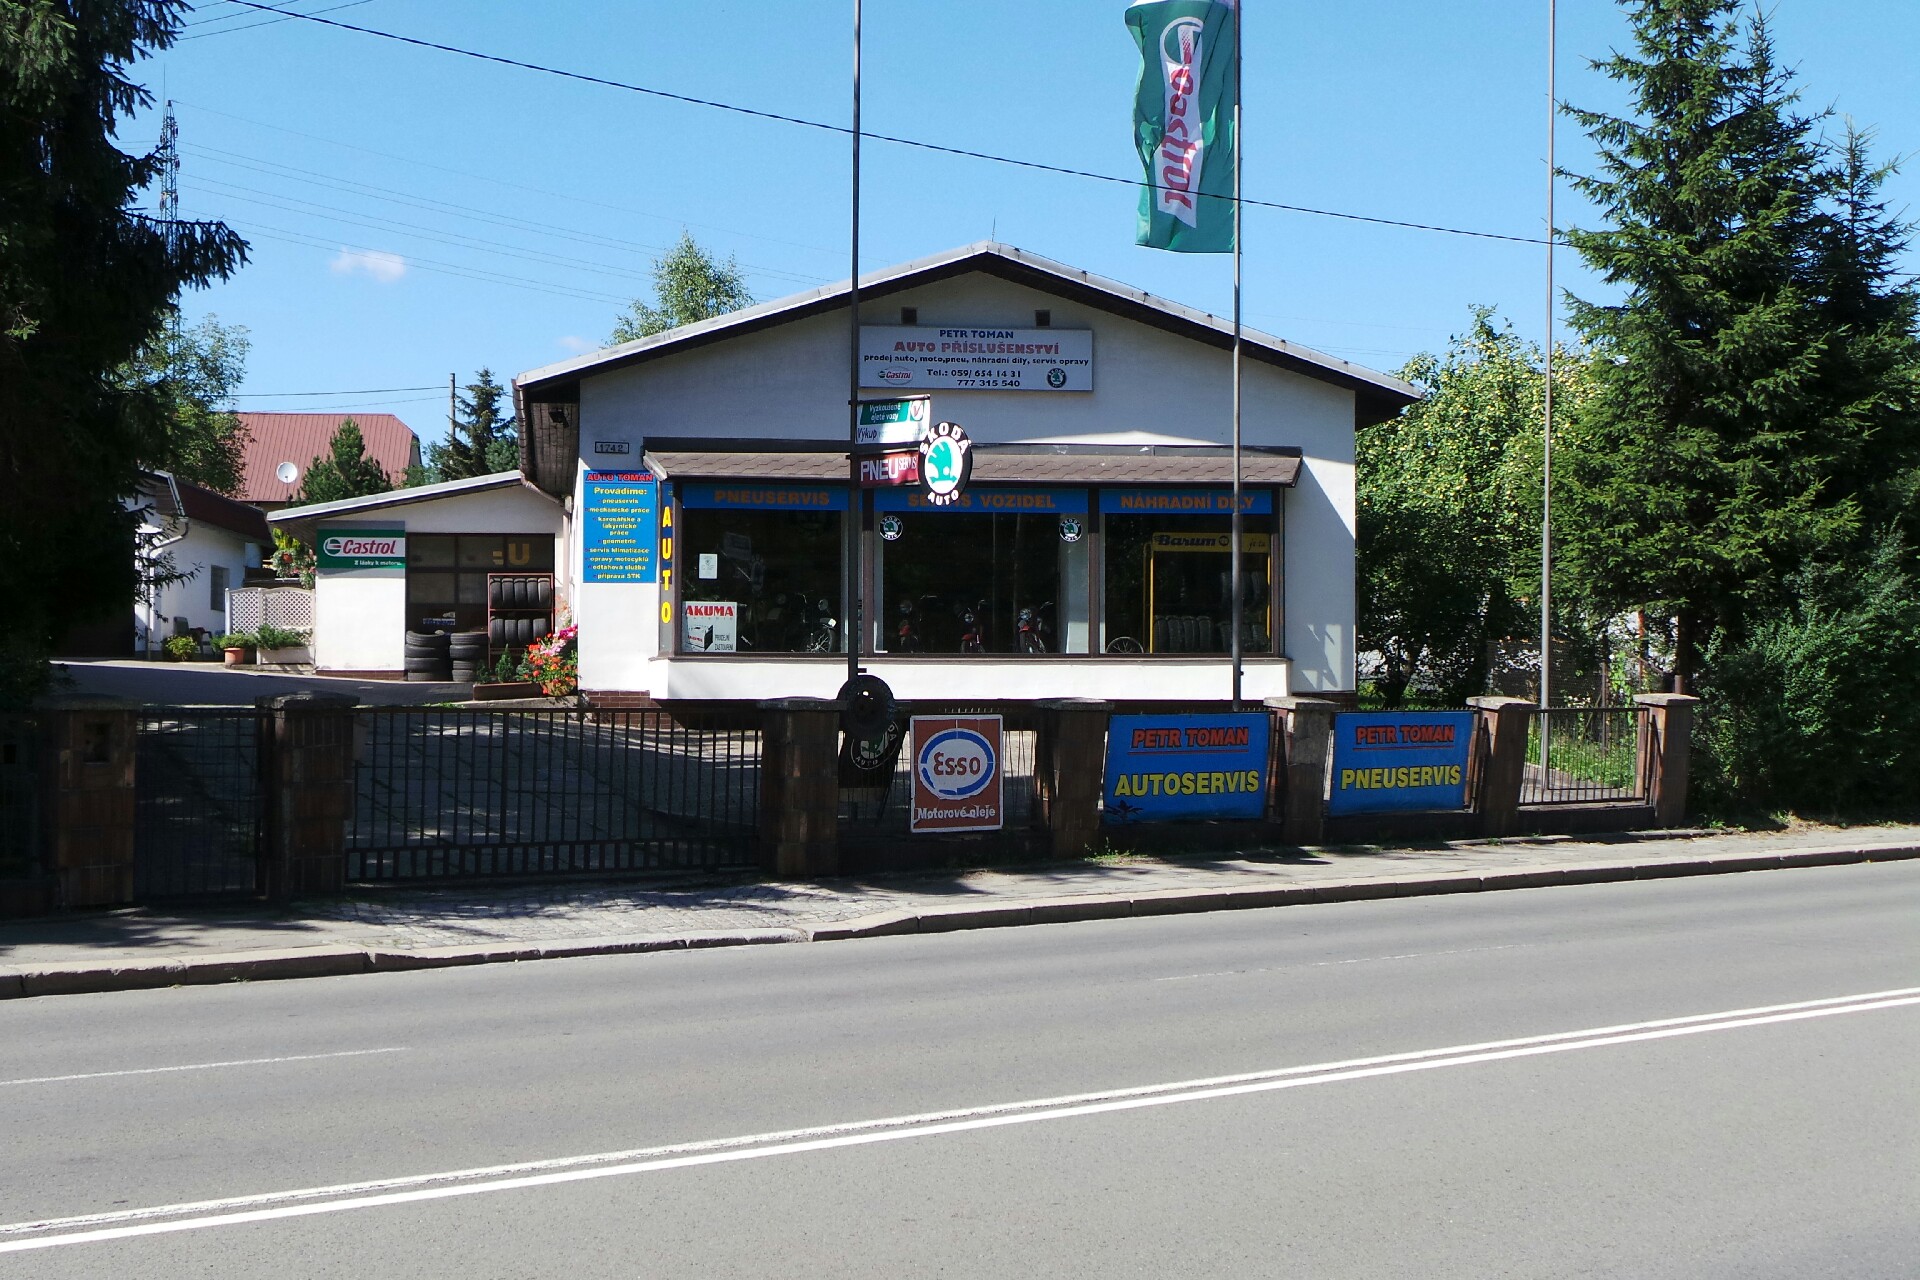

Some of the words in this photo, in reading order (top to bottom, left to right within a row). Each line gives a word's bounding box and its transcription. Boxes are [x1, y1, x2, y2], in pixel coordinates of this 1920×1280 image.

[940, 330, 968, 338] PETR
[971, 330, 1014, 339] TOMAN
[894, 341, 936, 353] AUTO
[941, 340, 1059, 354] PŘÍSLUŠENSTVÍ
[864, 354, 893, 363] prodej
[894, 355, 918, 363] auto,
[971, 356, 1010, 364] náhradní
[1059, 358, 1089, 366] opravy
[926, 369, 948, 377] Tel.:
[974, 370, 992, 378] 654
[996, 370, 1007, 378] 14
[1010, 370, 1021, 378] 31
[886, 413, 899, 422] vozy
[857, 427, 878, 442] Výkup
[586, 472, 614, 481] AUTO
[618, 473, 654, 482] TOMAN
[714, 490, 830, 505] PNEUSERVIS
[908, 493, 972, 508] SES
[980, 494, 1056, 508] VOZIDEL
[927, 489, 959, 506] AUTO
[1121, 492, 1212, 509] NÁHRADNÍ
[343, 540, 396, 554] Castrol
[1156, 535, 1216, 546] Barum
[685, 605, 734, 617] AKUMA
[1131, 728, 1181, 748] PETR
[1185, 727, 1249, 747] TOMAN
[1356, 725, 1397, 744] PETR
[1400, 724, 1455, 743] TOMAN
[1113, 770, 1260, 797] AUTOSERVIS
[1341, 764, 1461, 790] PNEUSERVIS
[916, 806, 967, 819] Motorové
[969, 804, 996, 819] oleje
